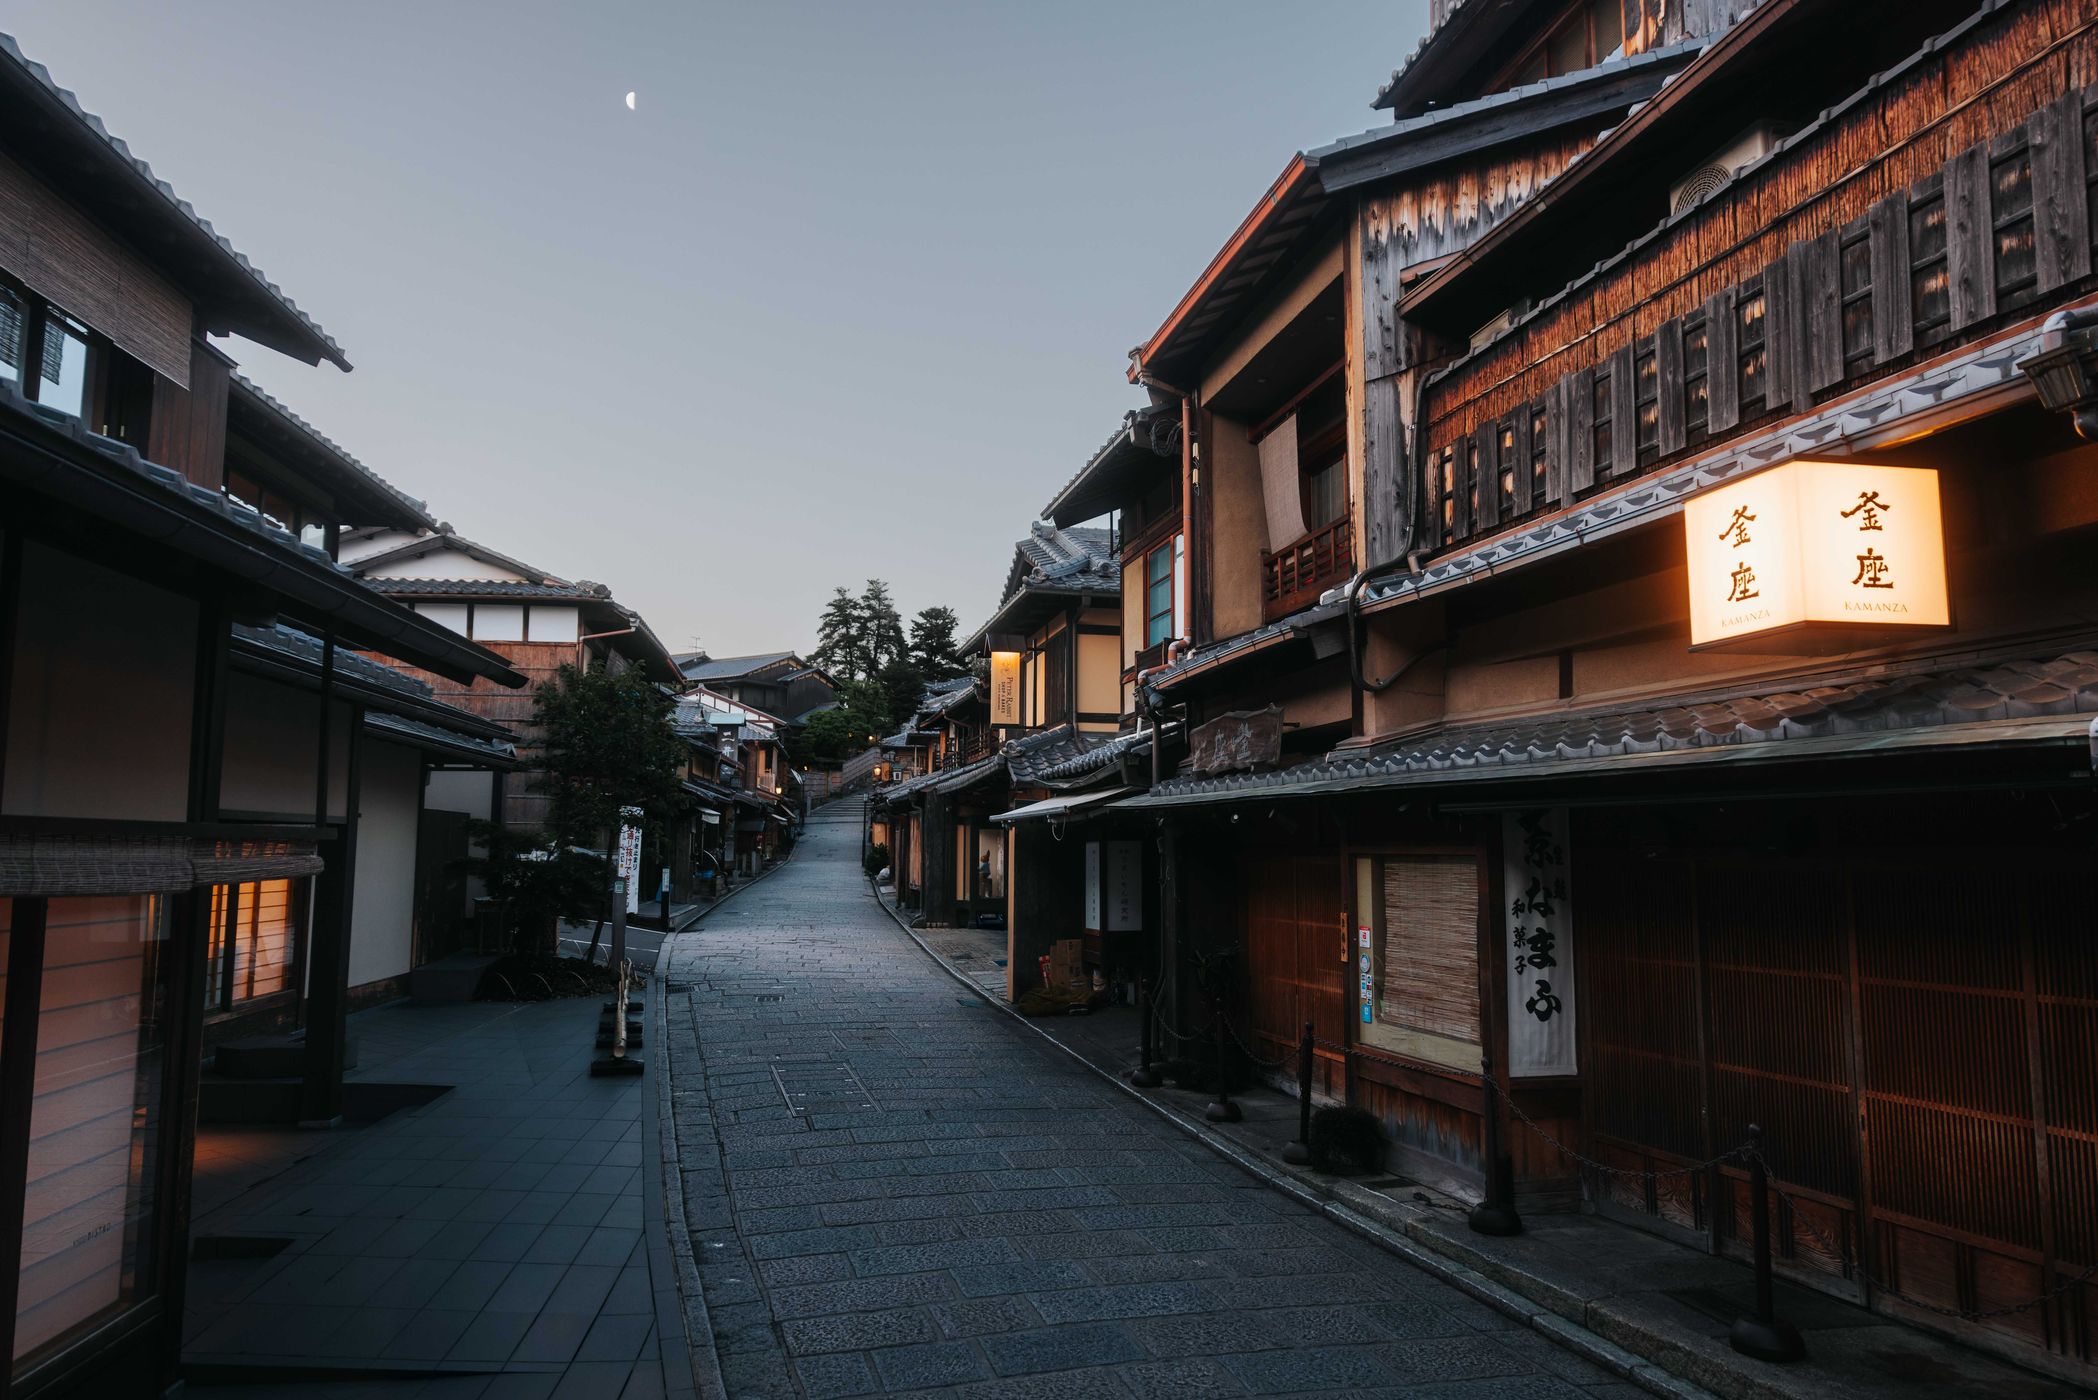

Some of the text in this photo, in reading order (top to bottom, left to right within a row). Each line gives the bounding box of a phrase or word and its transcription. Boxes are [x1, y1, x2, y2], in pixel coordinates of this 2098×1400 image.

[1719, 505, 1760, 602] 釜座
[1840, 491, 1894, 589] 釜座
[1721, 609, 1770, 629] KAMANZA
[1844, 601, 1908, 613] KAMANZA
[1511, 898, 1528, 976] 和菓子
